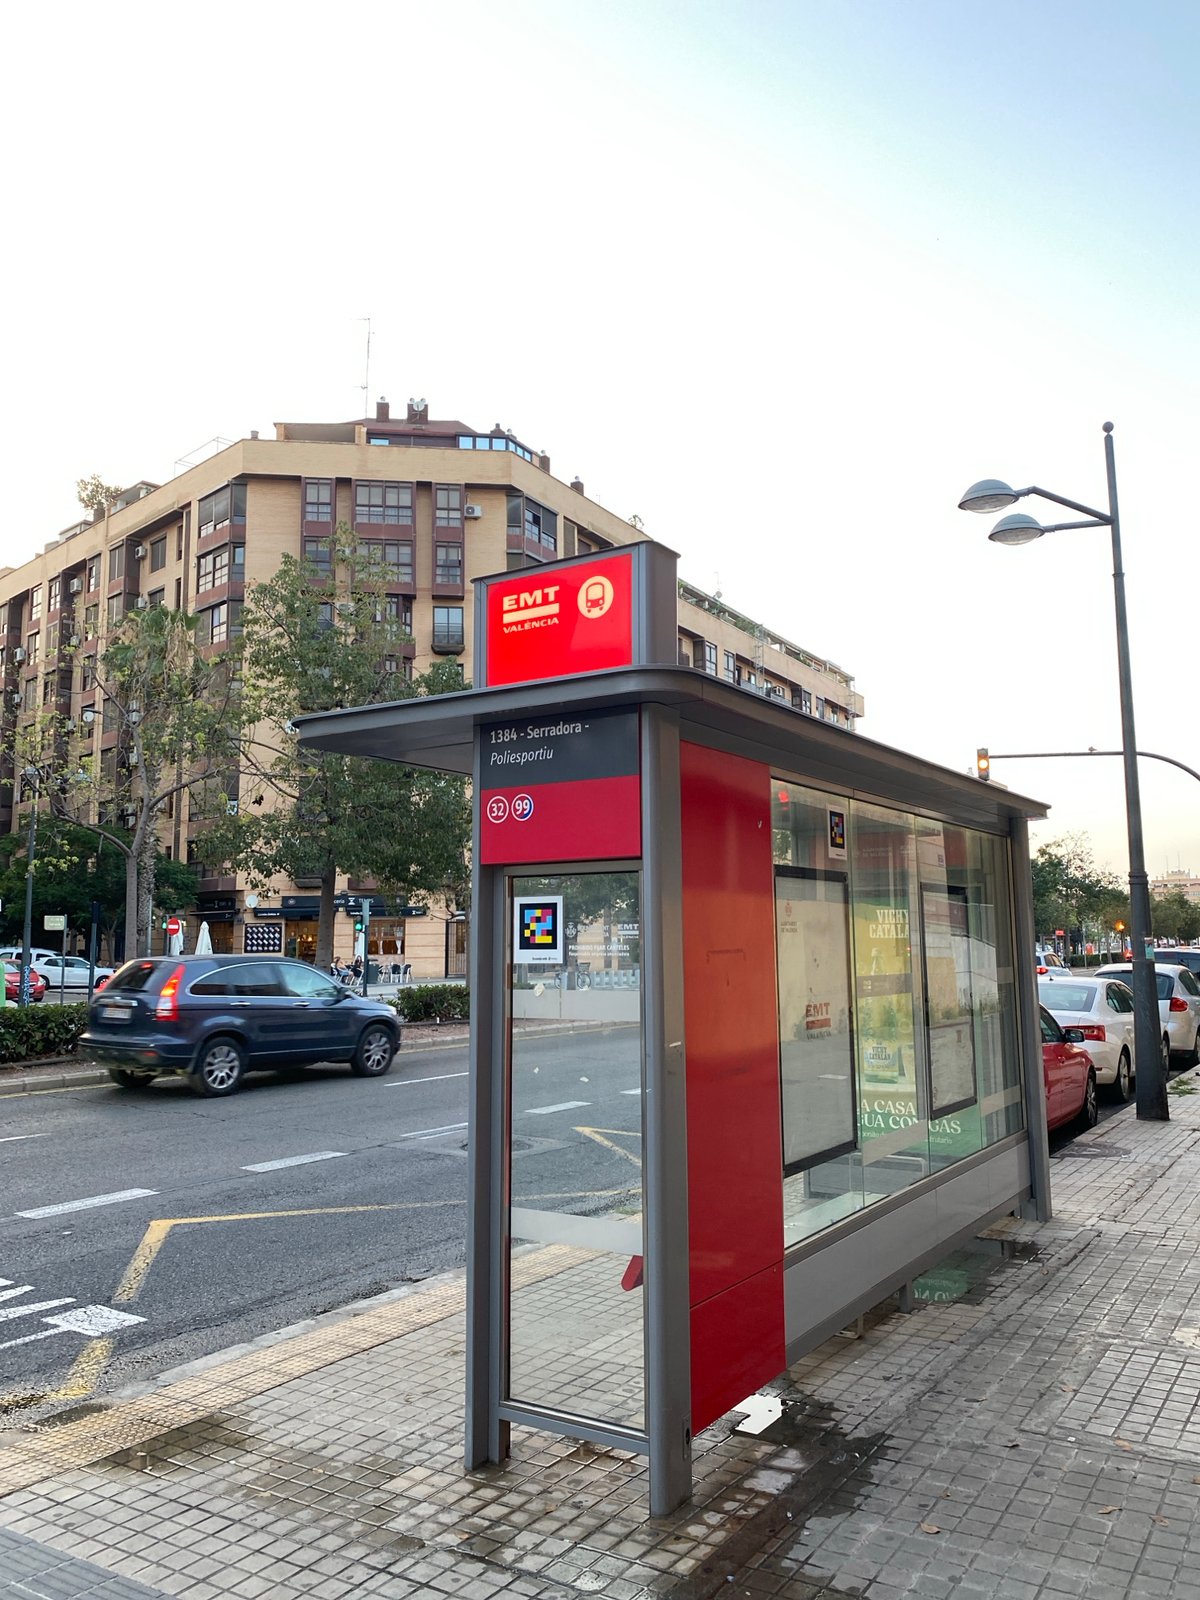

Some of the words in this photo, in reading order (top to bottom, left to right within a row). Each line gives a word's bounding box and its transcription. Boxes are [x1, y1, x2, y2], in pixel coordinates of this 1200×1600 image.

[503, 585, 560, 611] EMT
[503, 617, 559, 634] VALÈNCIA
[490, 728, 517, 744] 1384
[527, 721, 582, 739] Serradora
[490, 745, 554, 766] Poliesportiu
[491, 802, 505, 817] 32
[515, 799, 531, 815] 99
[876, 909, 909, 924] VICHY
[869, 924, 910, 938] CATALA
[805, 1002, 830, 1018] EMT
[874, 1099, 916, 1116] CASA
[928, 1119, 961, 1134] GAS
